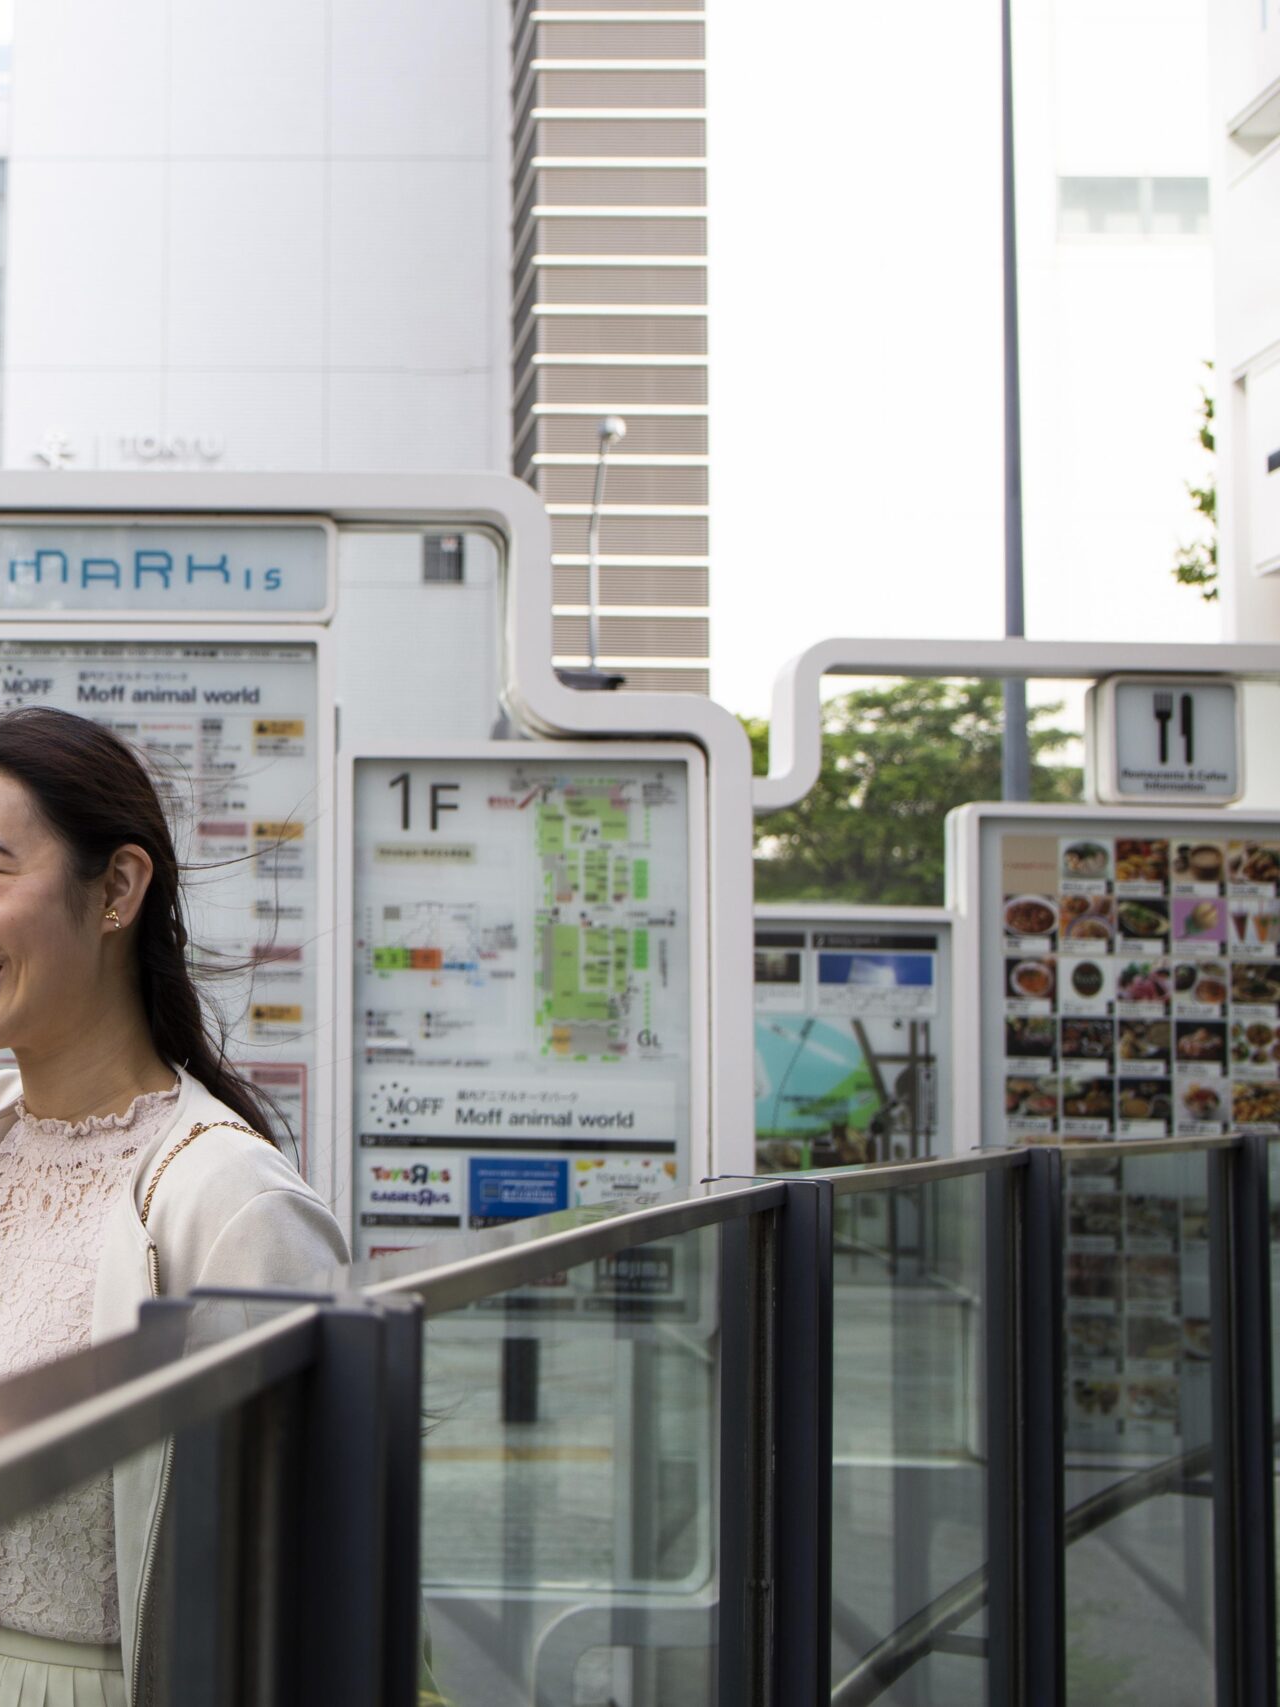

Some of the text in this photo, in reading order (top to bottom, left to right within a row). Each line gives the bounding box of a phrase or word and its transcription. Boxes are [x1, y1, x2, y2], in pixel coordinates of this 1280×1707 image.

[77, 686, 261, 704] Moff animal world
[388, 772, 460, 831] 1F
[455, 1107, 634, 1129] Moff animal world
